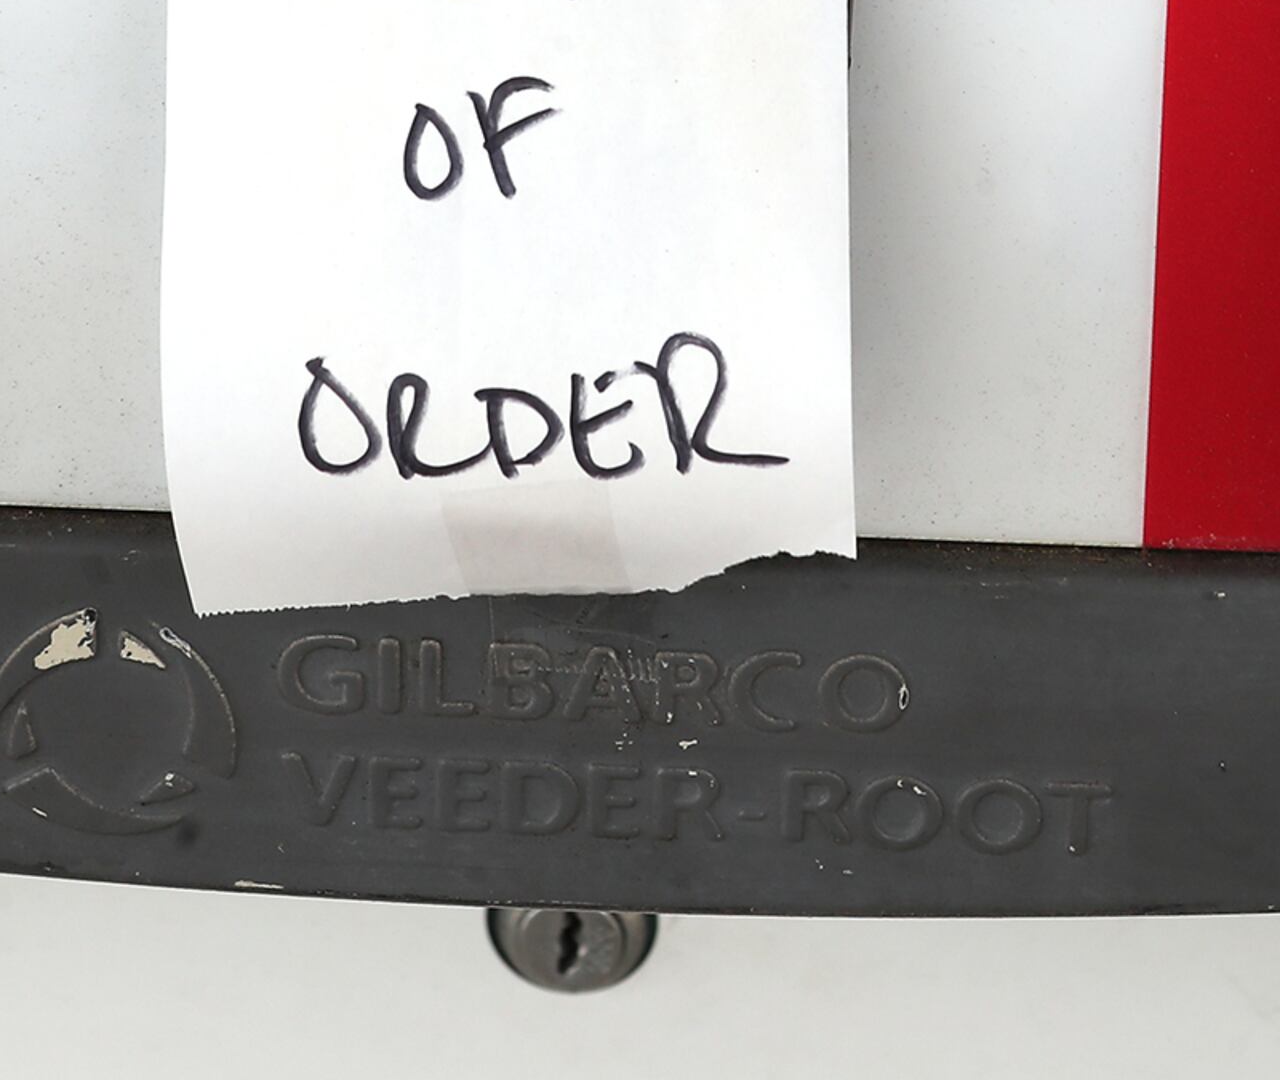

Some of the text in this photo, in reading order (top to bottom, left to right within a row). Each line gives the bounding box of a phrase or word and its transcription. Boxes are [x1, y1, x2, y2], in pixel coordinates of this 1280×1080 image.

[403, 76, 554, 200] OF
[297, 332, 790, 480] ORDER
[276, 634, 910, 732] GILBARCO
[280, 751, 1114, 857] VEEDER-ROOT
